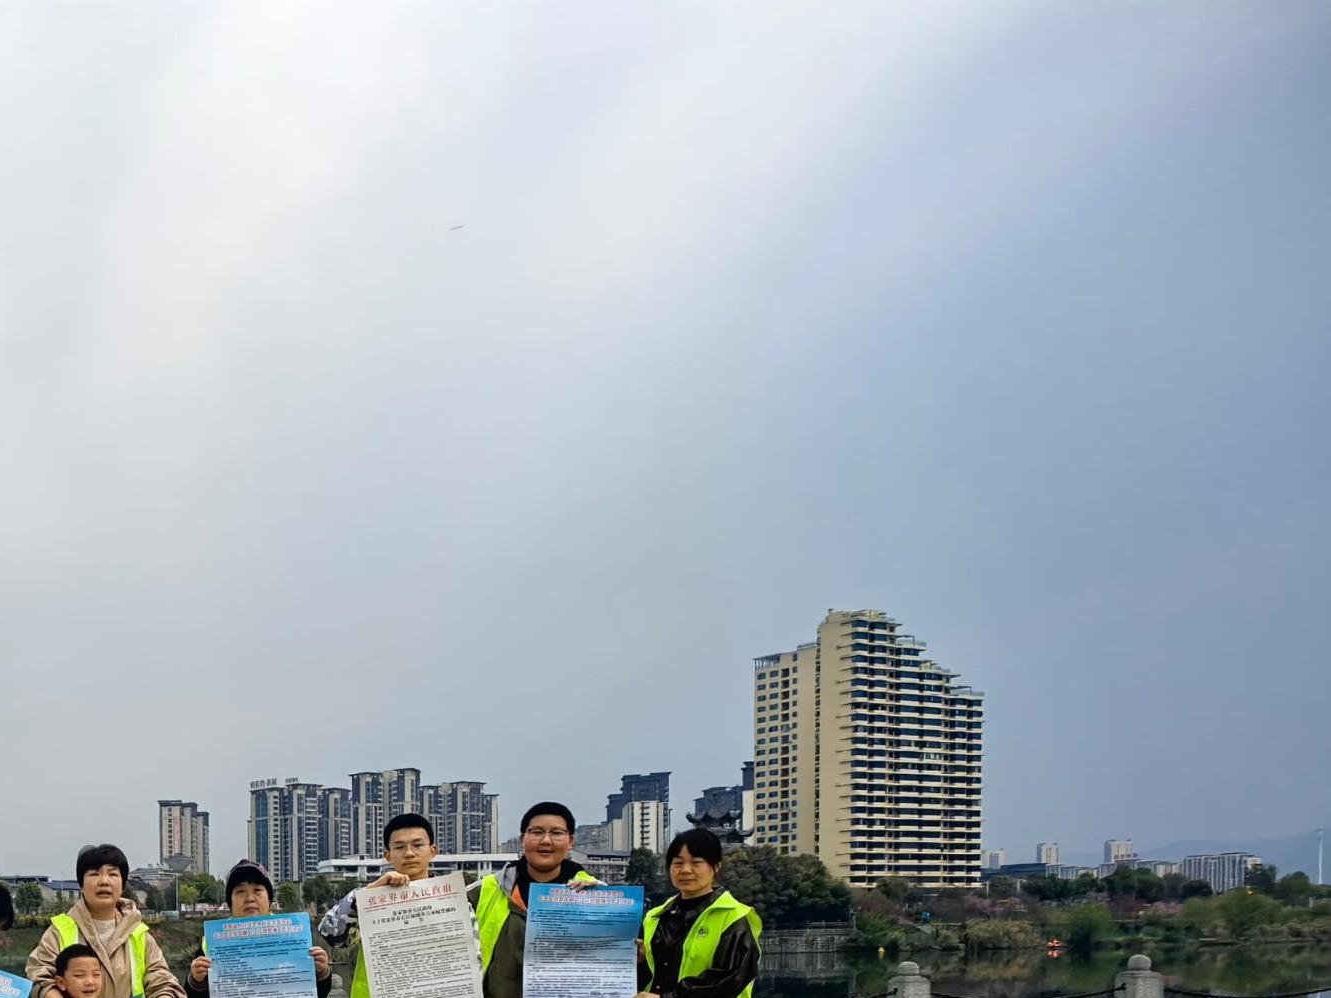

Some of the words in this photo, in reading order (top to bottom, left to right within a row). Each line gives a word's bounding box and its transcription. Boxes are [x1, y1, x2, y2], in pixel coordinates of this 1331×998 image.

[367, 883, 452, 905] 张家界市人民政府
